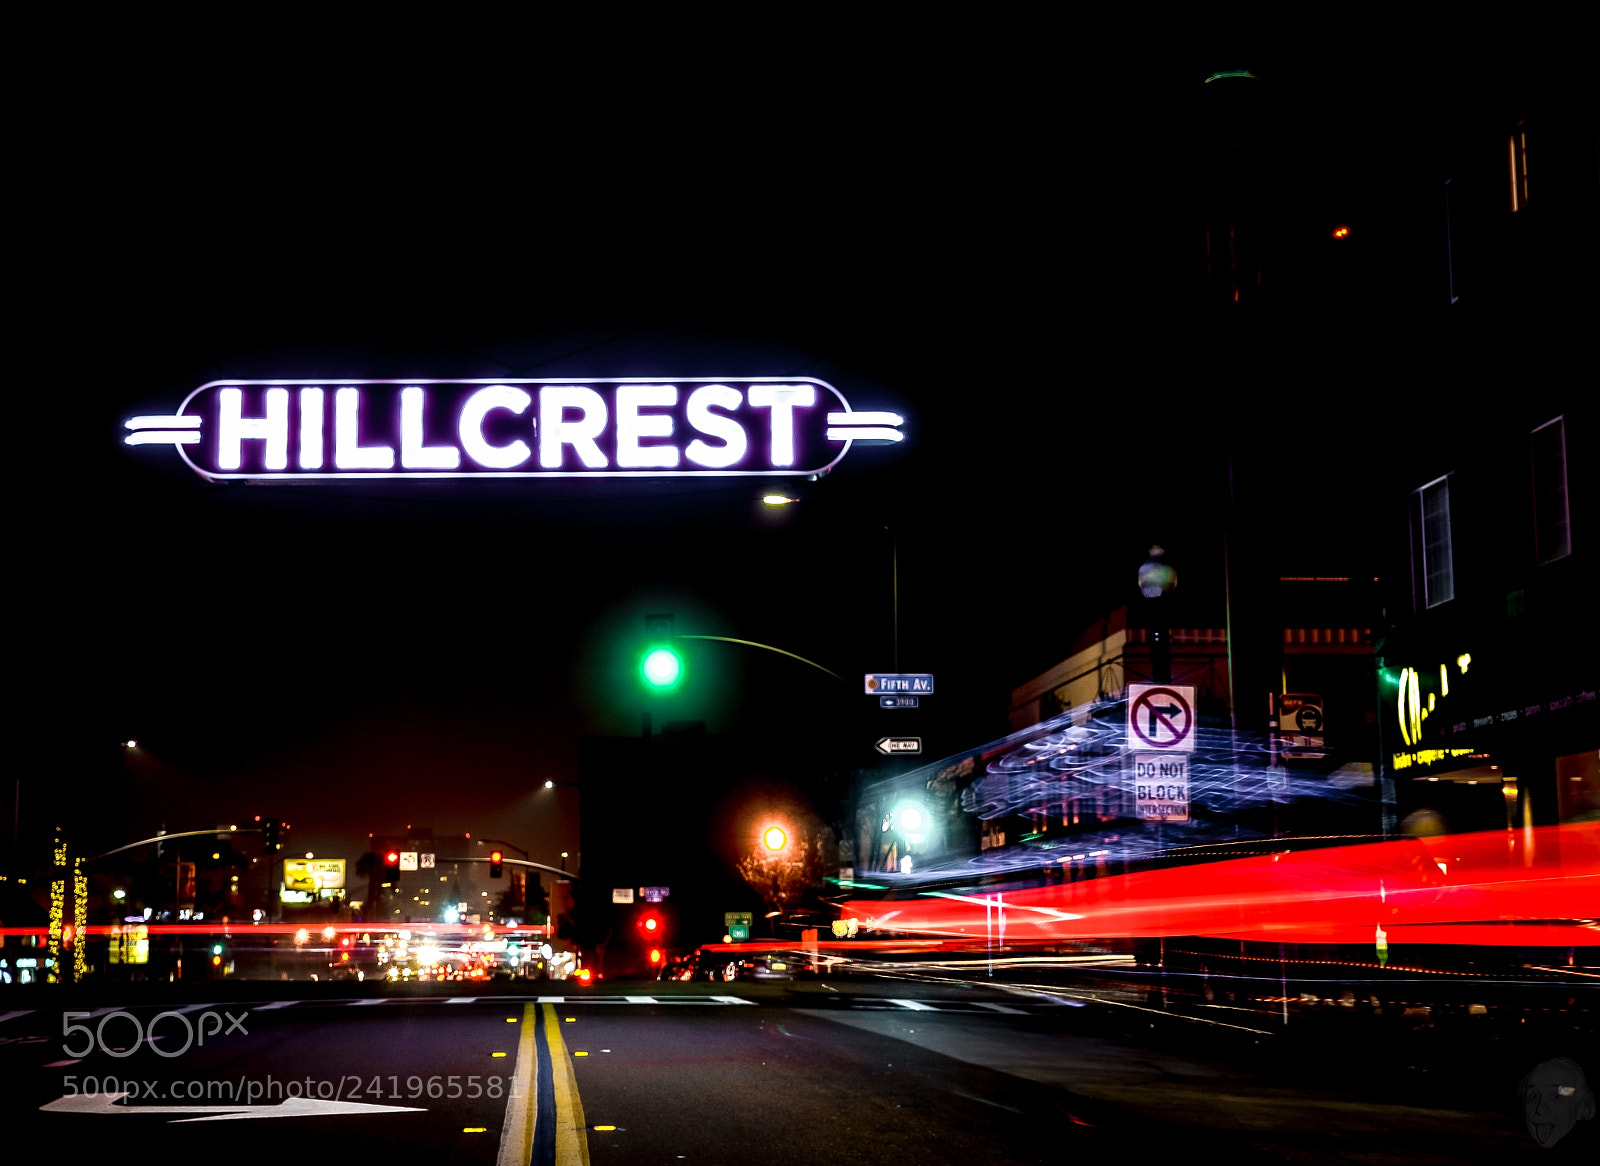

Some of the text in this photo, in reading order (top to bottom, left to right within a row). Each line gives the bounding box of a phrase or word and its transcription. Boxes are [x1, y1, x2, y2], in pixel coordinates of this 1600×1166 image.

[218, 384, 816, 470] HILLCREST
[880, 678, 909, 691] FIFTH
[1137, 762, 1186, 778] DO NOT
[1137, 785, 1186, 801] BLOCK
